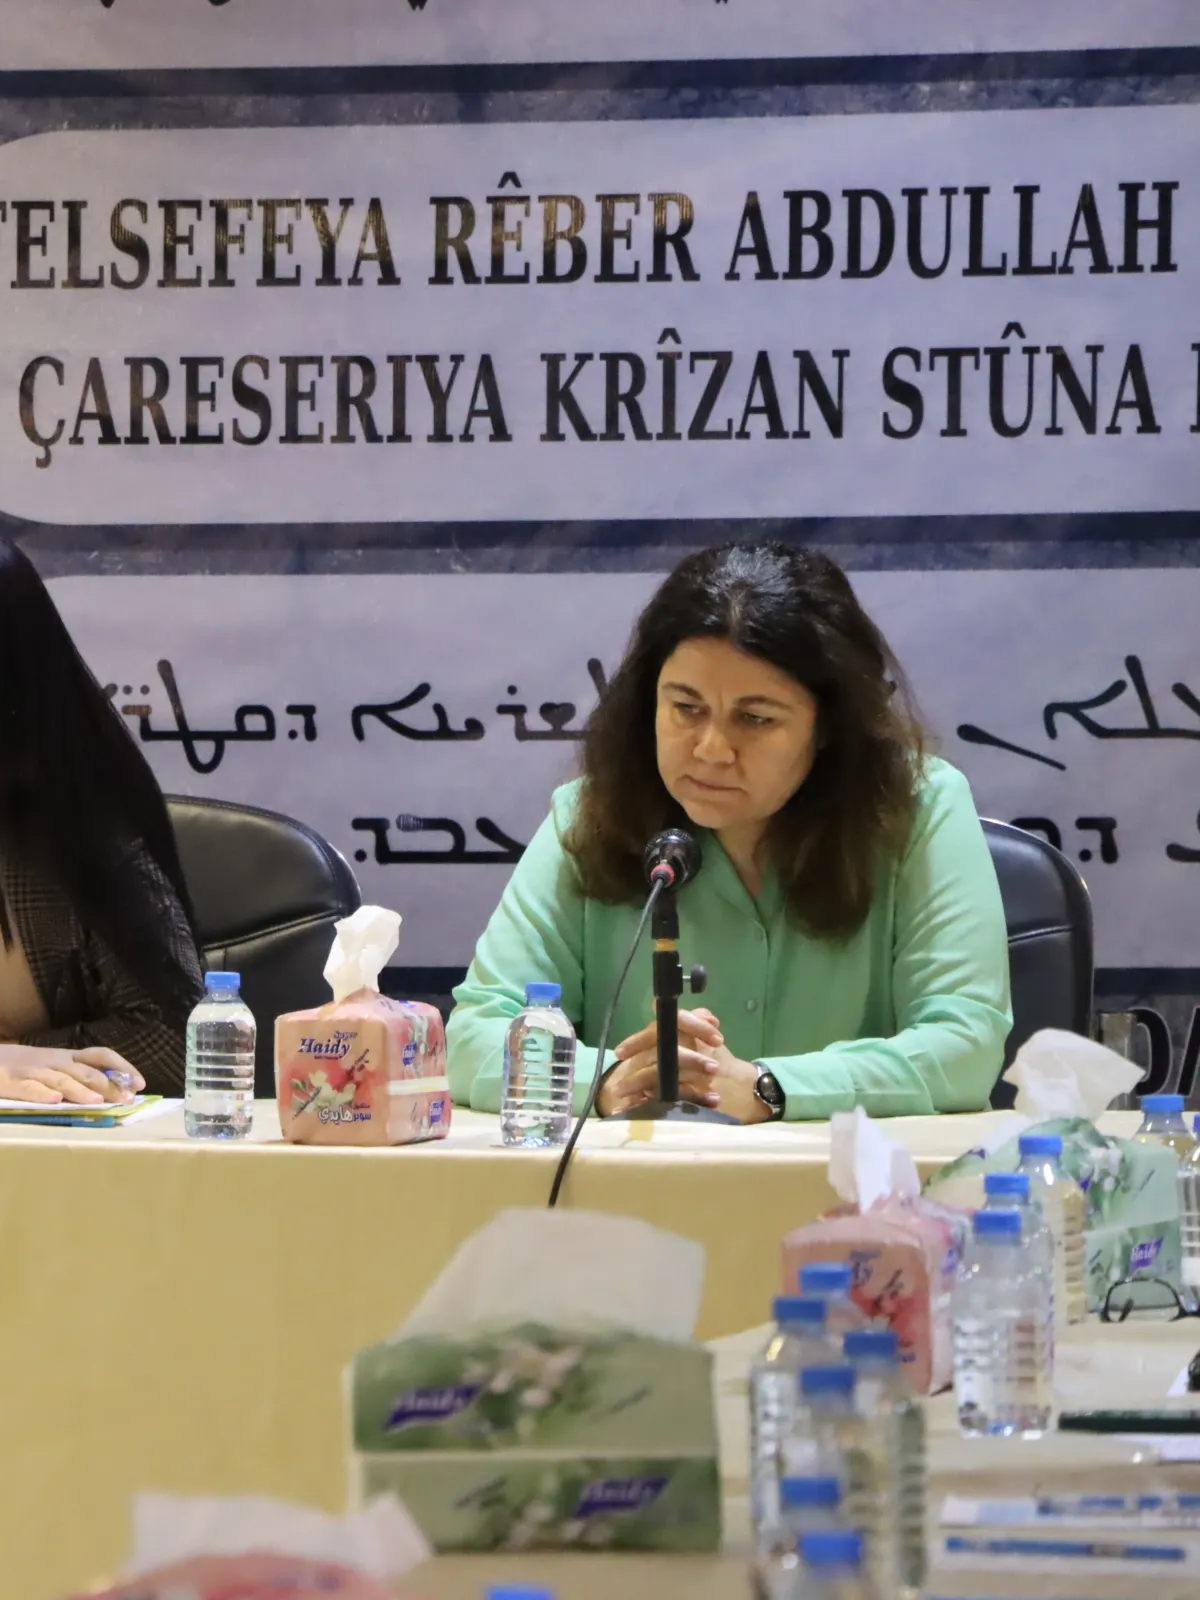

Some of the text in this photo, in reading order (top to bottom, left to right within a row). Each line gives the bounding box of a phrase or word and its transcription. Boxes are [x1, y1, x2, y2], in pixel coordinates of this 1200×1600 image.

[428, 172, 700, 285] RÊBER
[725, 181, 1179, 281] ABDULLAH
[19, 354, 512, 468] ÇARESERIYA
[540, 328, 850, 441] KRÎZAN
[883, 322, 1161, 439] STÛNA
[298, 1038, 351, 1059] Haidy
[318, 1104, 353, 1124] هايدي
